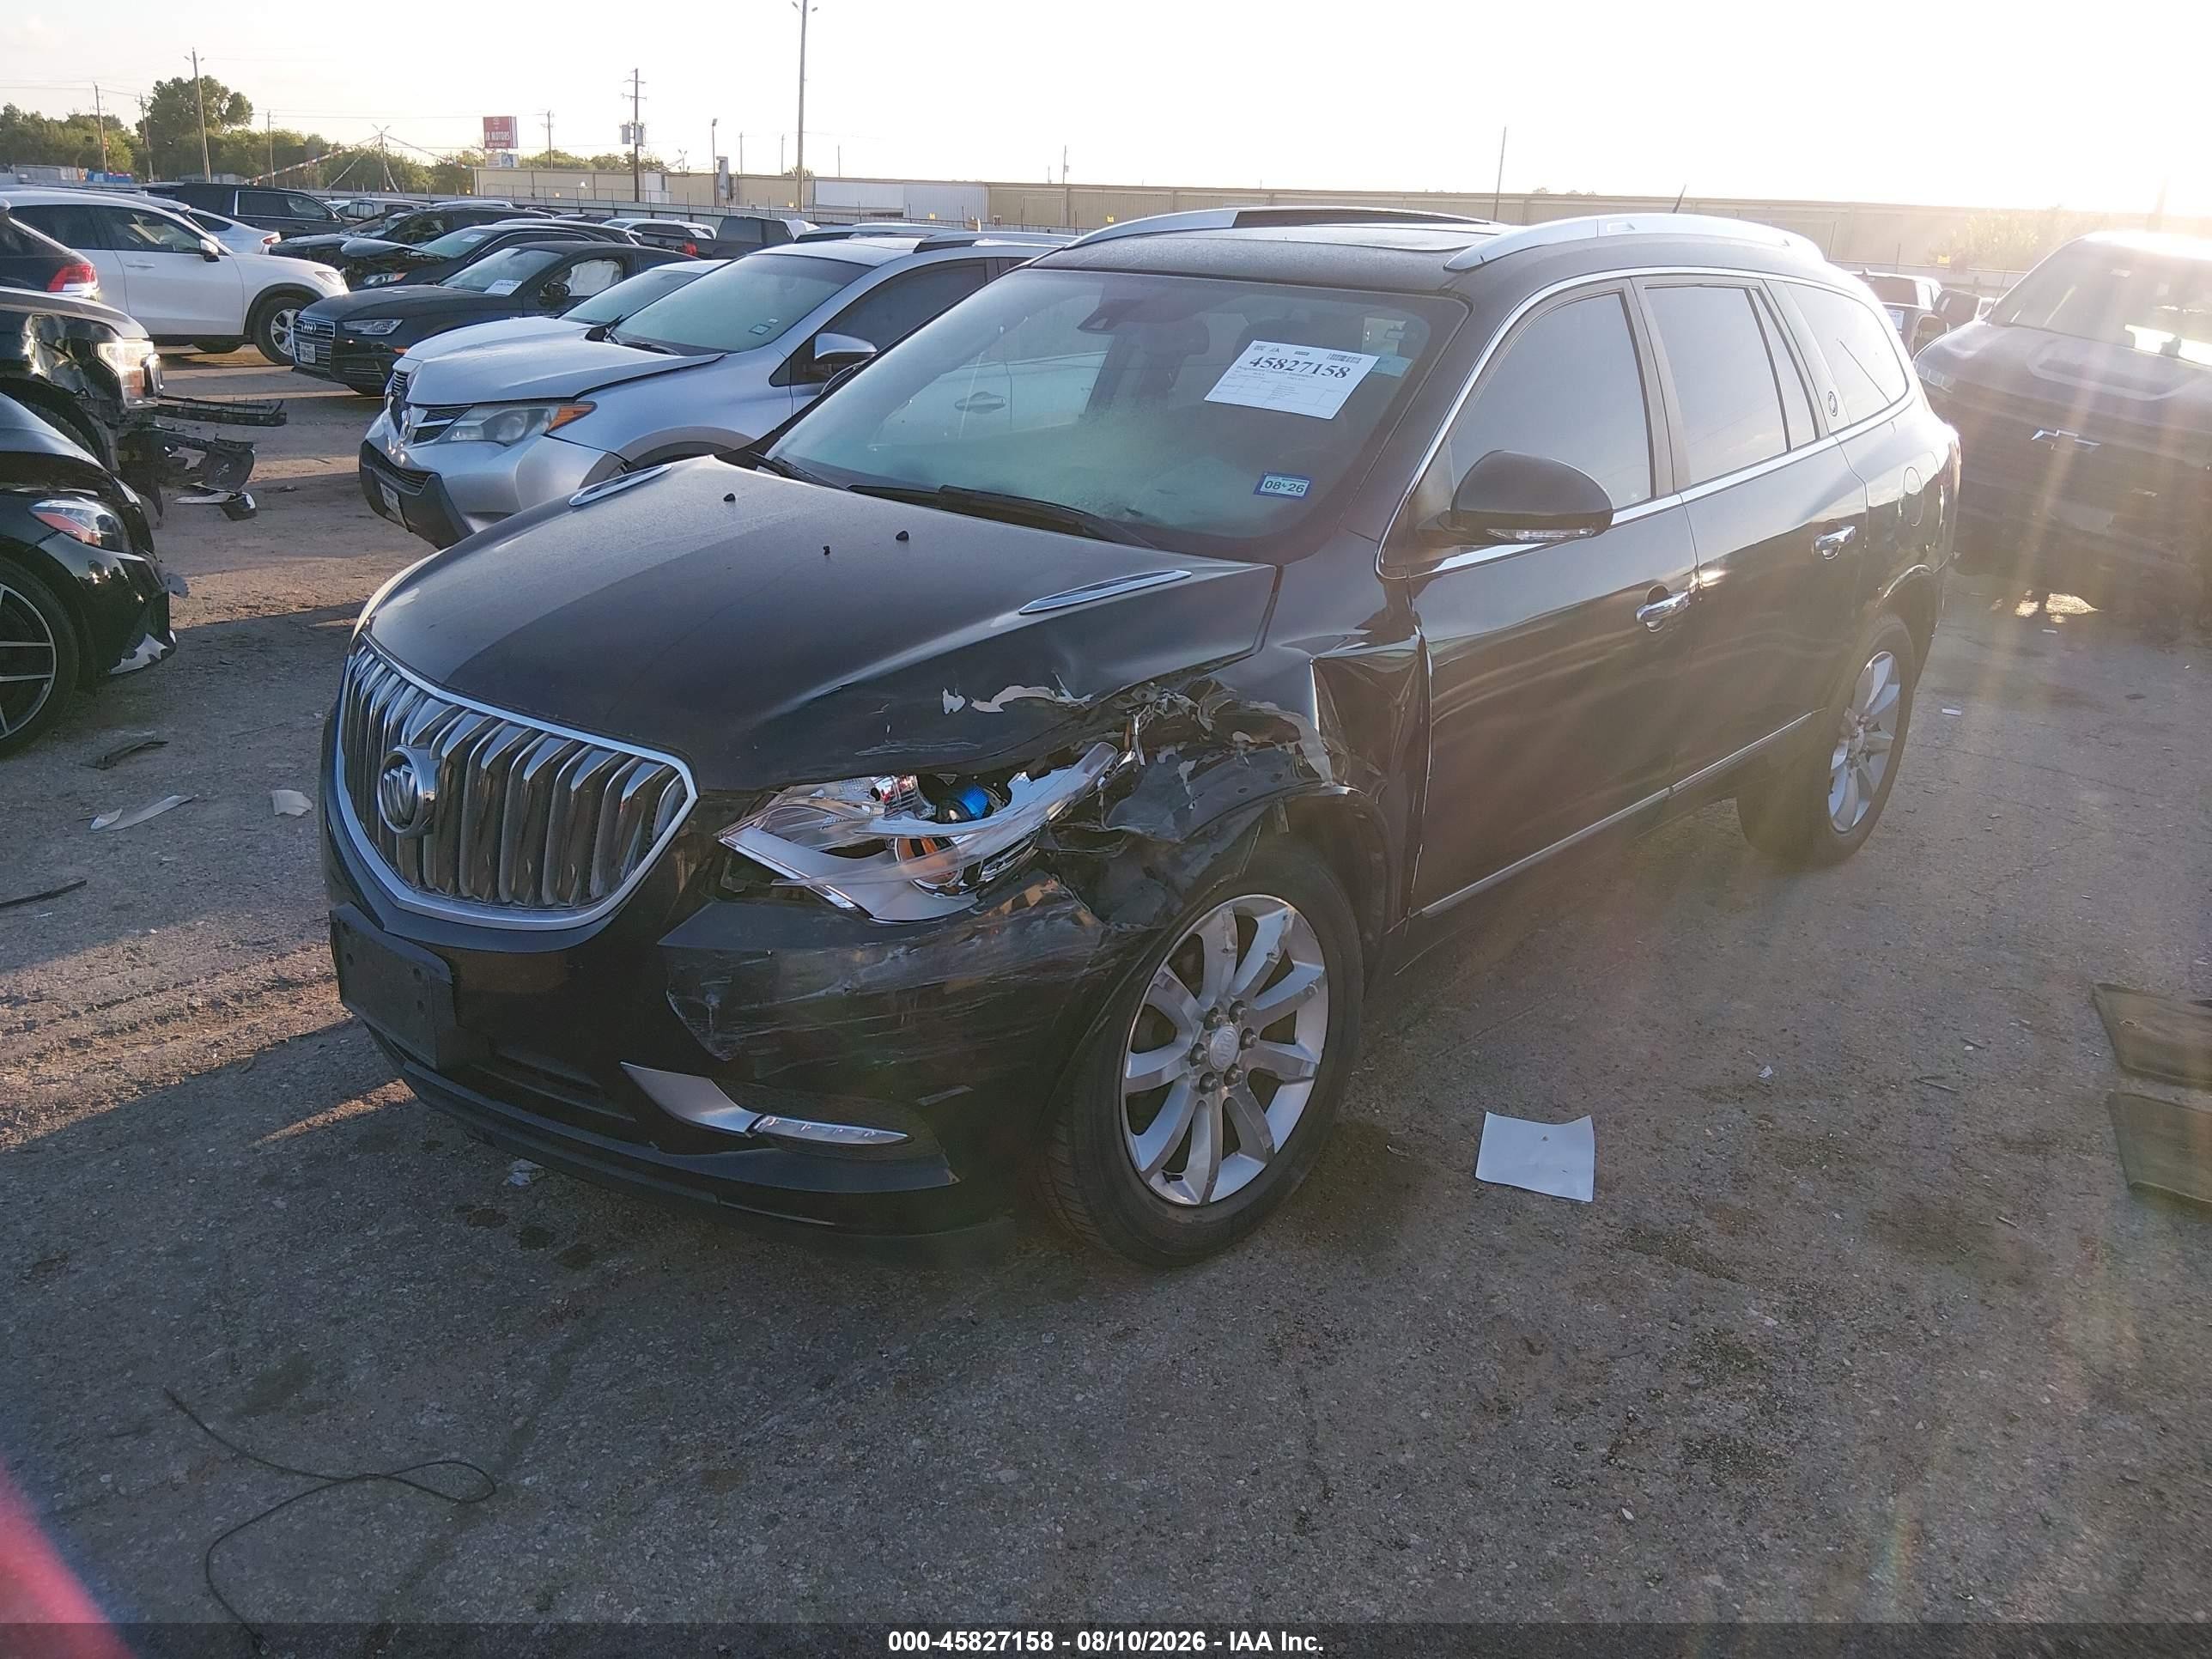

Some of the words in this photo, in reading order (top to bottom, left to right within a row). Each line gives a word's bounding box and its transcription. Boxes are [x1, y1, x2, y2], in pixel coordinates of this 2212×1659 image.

[1249, 356, 1352, 379] 45827158
[1264, 480, 1282, 490] 08
[1287, 483, 1305, 493] 26
